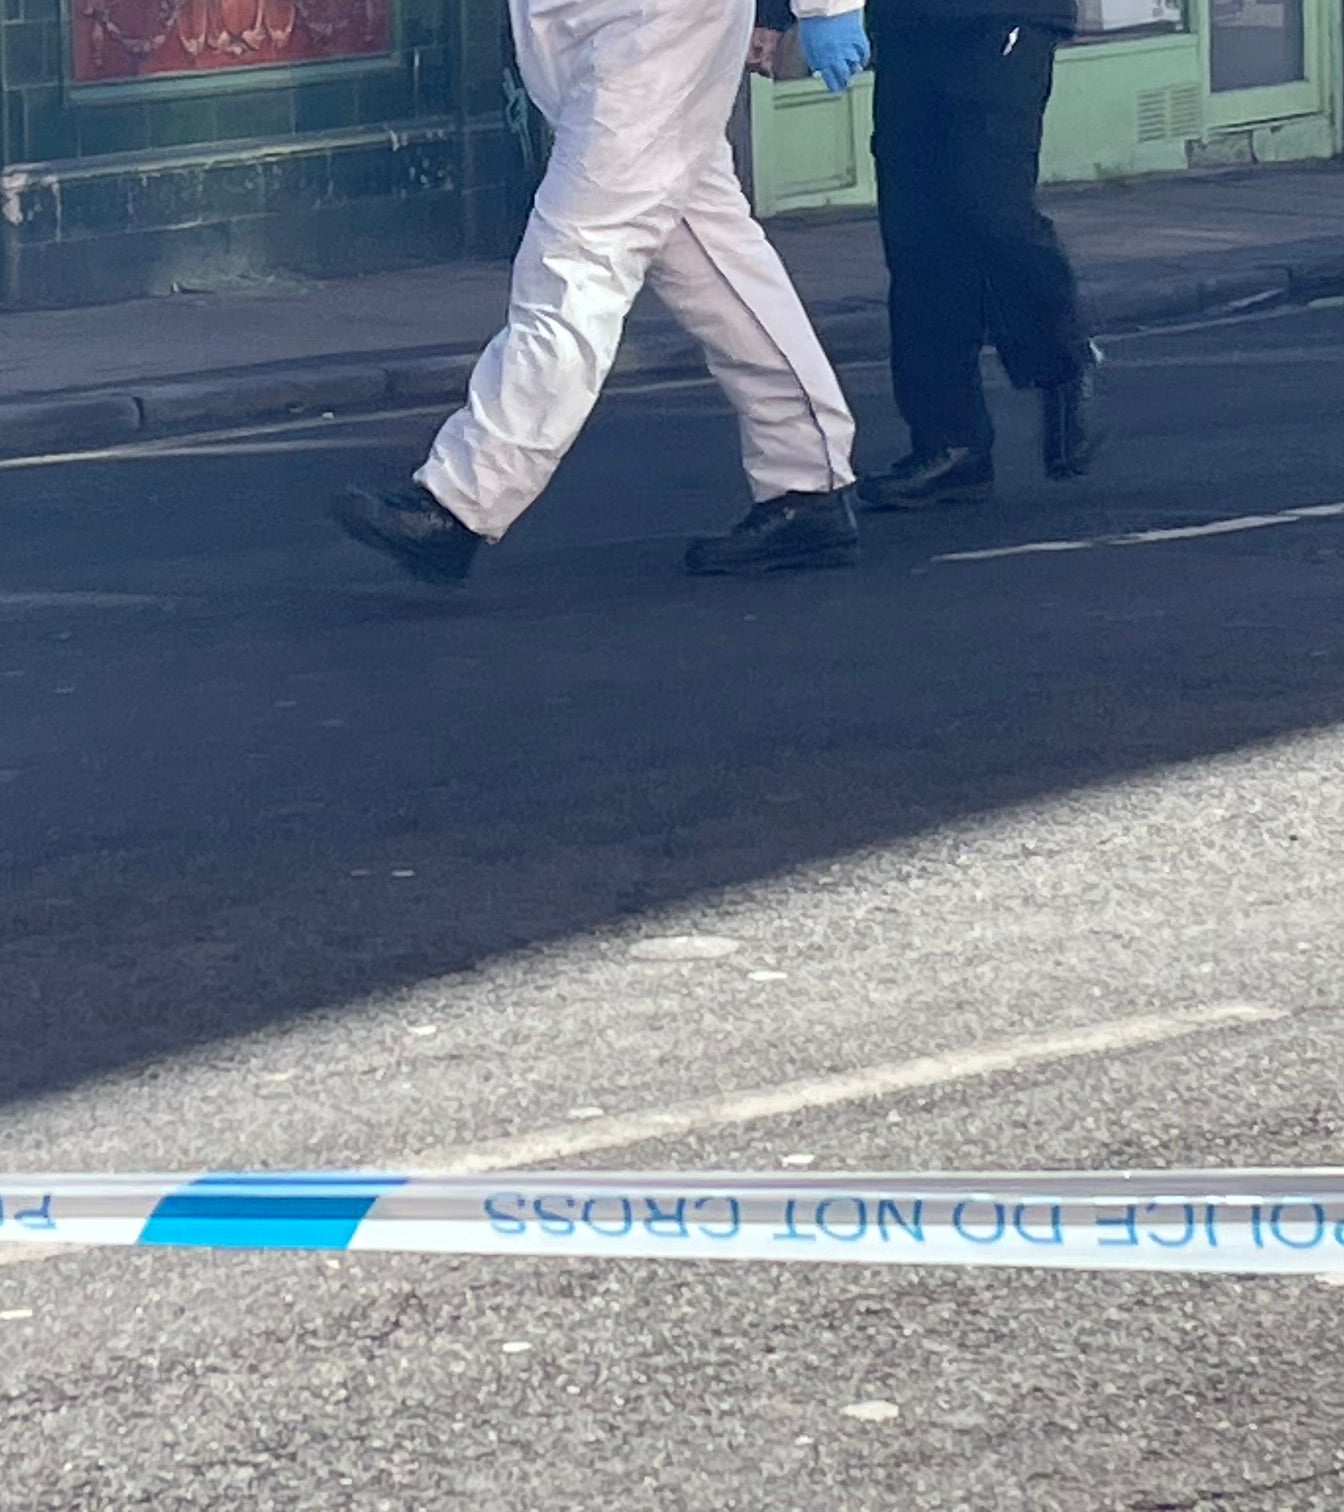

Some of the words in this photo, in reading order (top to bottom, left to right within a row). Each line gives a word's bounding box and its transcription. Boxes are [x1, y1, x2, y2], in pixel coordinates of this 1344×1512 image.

[484, 1193, 741, 1240] CROSS
[773, 1196, 924, 1242] NOT
[951, 1199, 1064, 1248] DO
